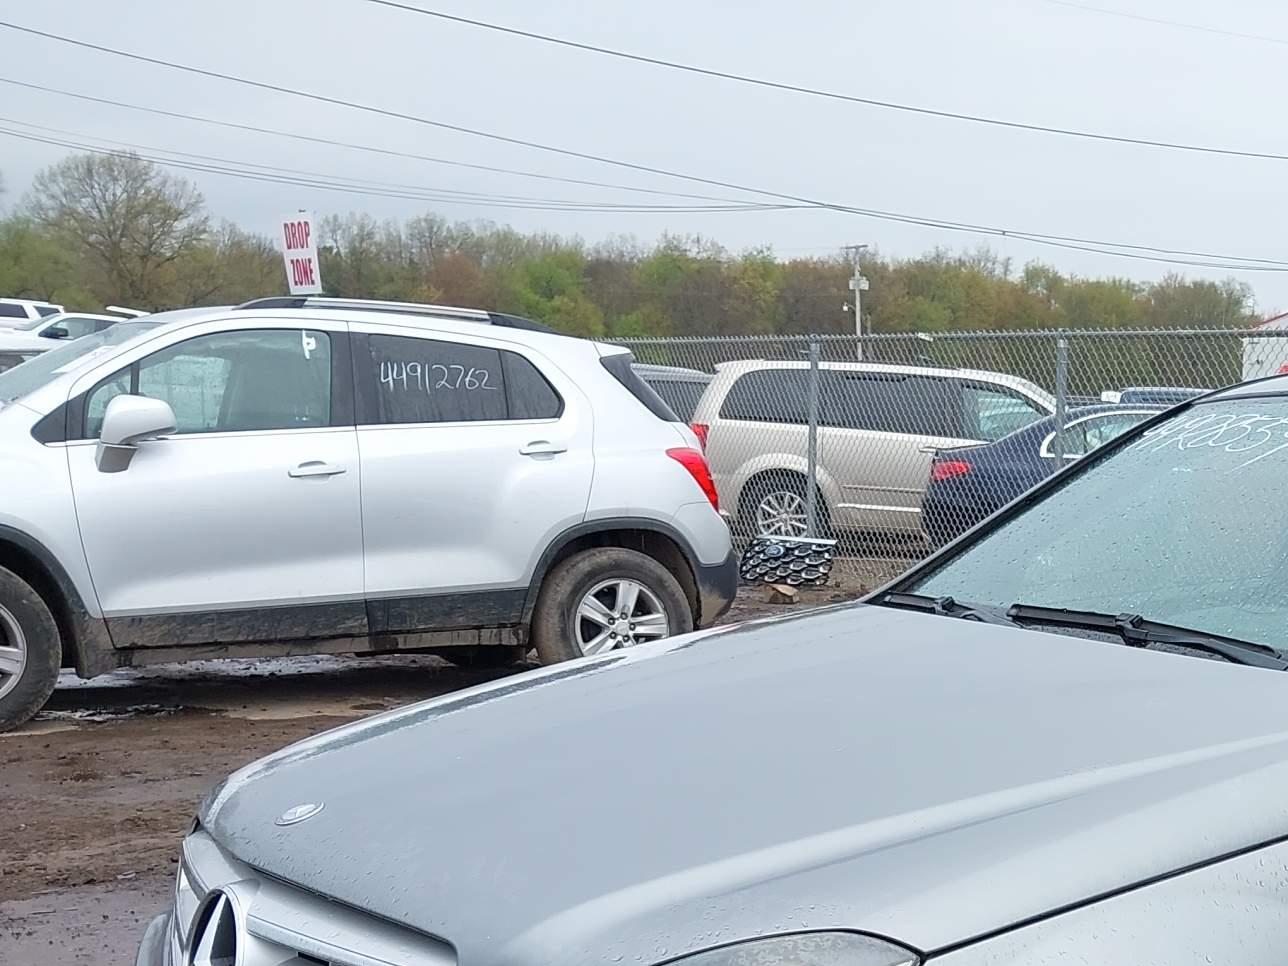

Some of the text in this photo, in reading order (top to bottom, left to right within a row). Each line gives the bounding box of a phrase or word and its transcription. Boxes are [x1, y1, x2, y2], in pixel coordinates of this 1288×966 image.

[283, 221, 310, 249] DROP
[290, 258, 315, 286] ZONE
[380, 361, 497, 395] 44912762
